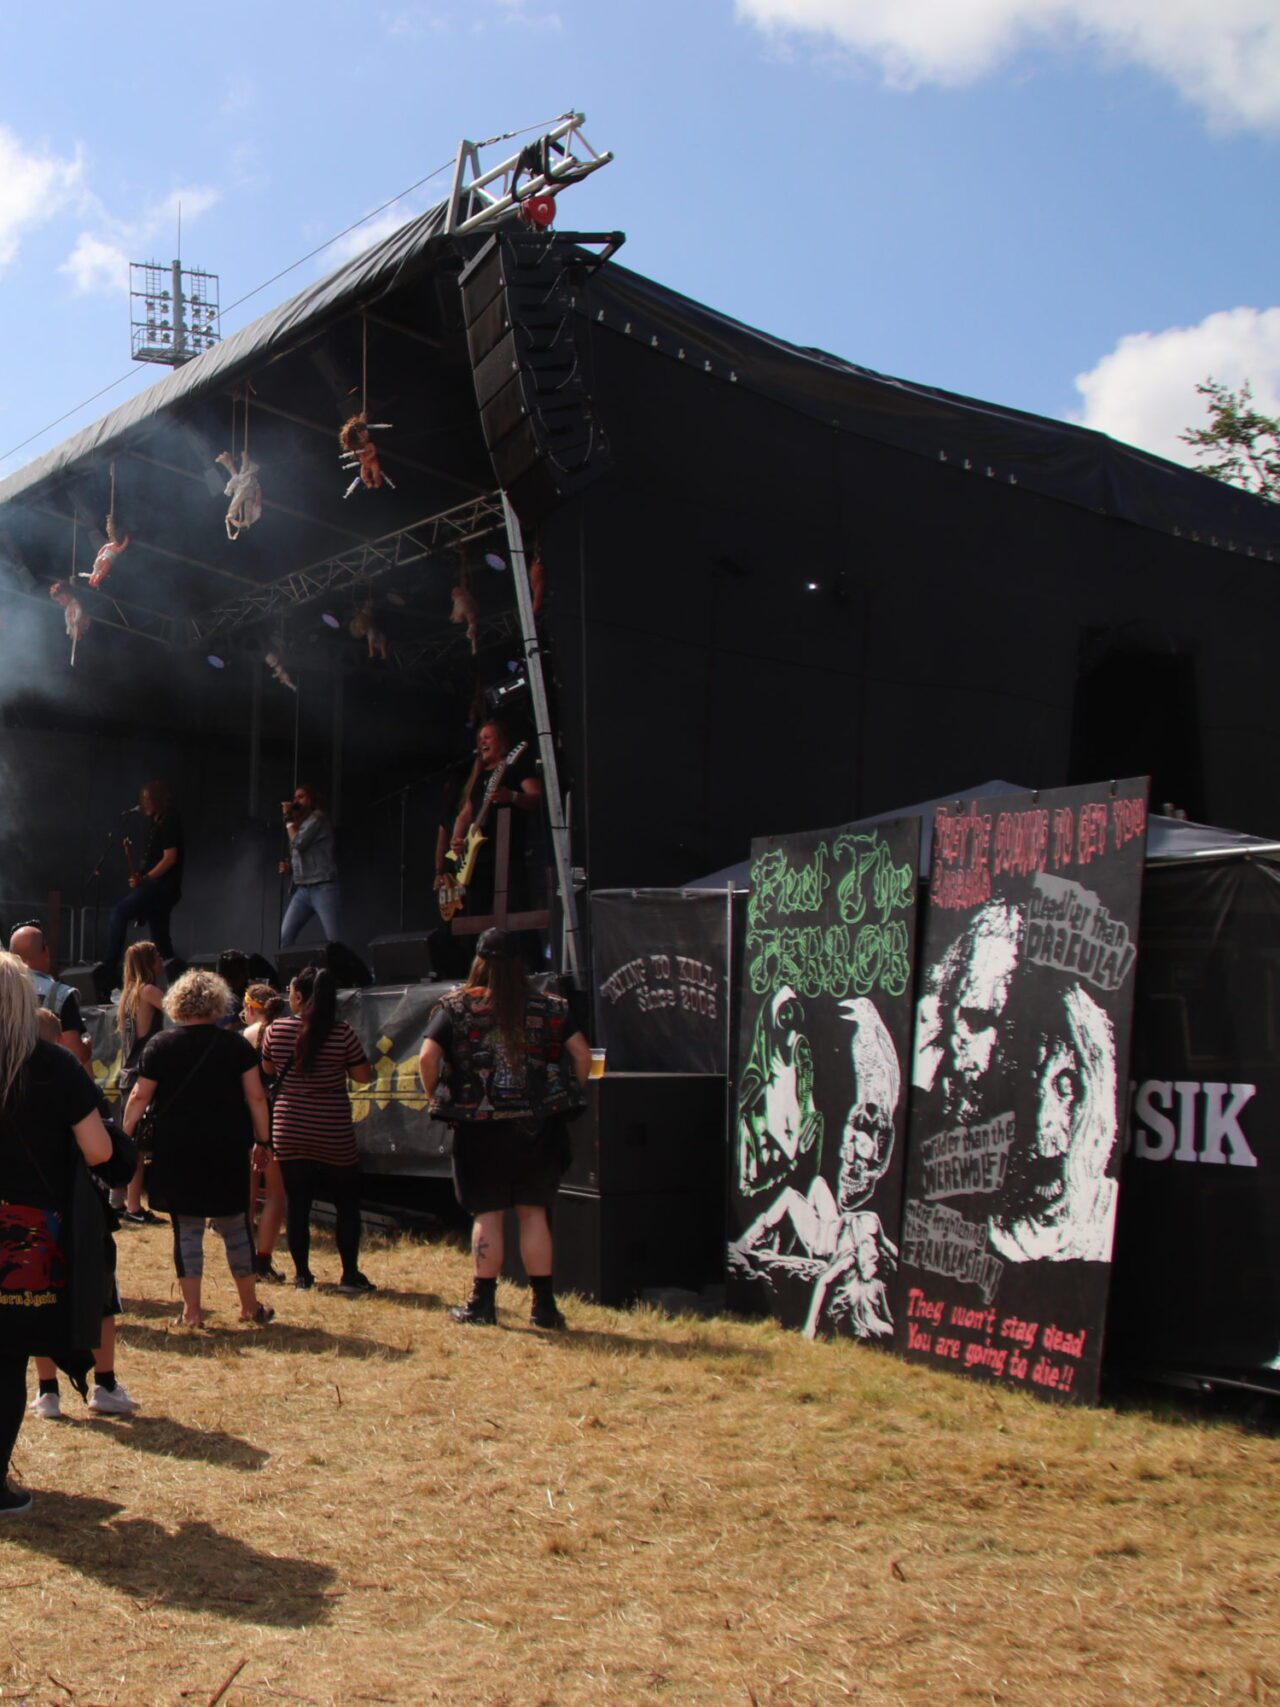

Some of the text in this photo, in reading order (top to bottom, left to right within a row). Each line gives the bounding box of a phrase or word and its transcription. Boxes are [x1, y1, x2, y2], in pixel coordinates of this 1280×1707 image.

[675, 955, 718, 992] KILL
[746, 920, 911, 998] TERROR
[907, 1288, 1087, 1360] They won't stay dead
[907, 1322, 1075, 1393] You are going to die!!
